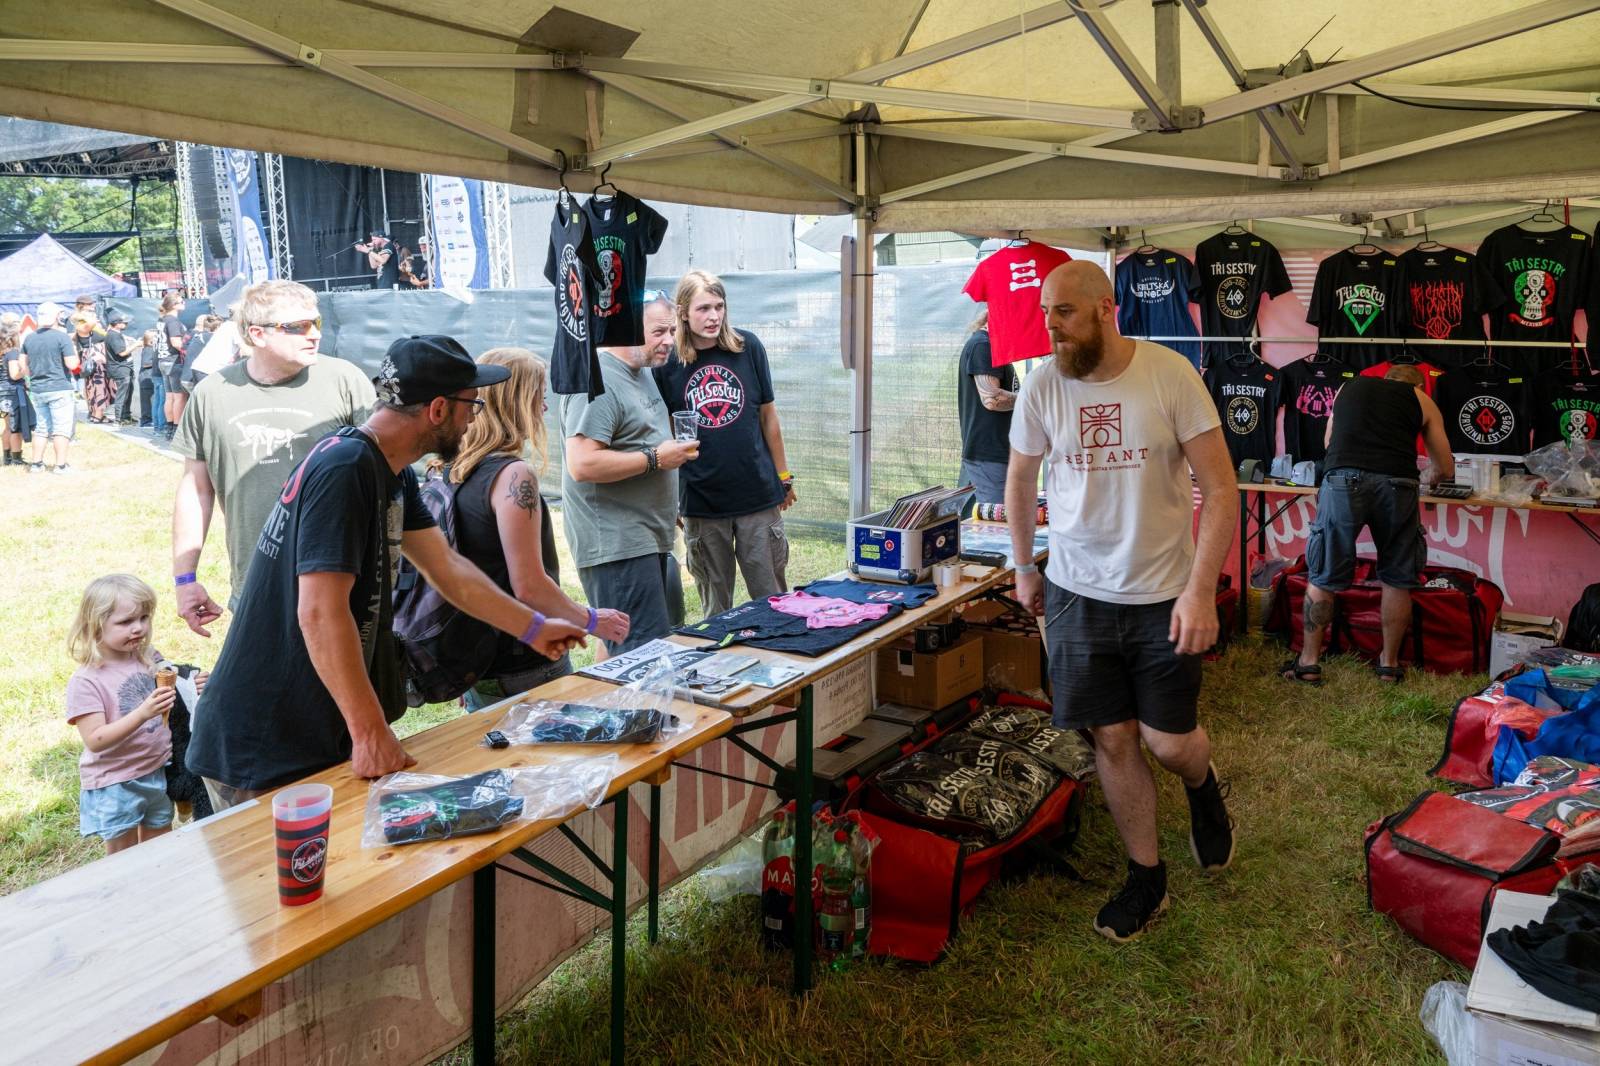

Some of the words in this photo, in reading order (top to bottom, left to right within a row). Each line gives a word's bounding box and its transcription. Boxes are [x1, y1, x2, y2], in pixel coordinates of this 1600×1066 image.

[1210, 261, 1226, 276] TŘI
[1526, 257, 1566, 278] SESTRY
[689, 366, 736, 387] ORIGINAL
[1221, 384, 1235, 396] TŘI
[1236, 384, 1267, 398] SESTRY
[1479, 398, 1508, 414] SESTRY
[716, 408, 738, 426] 1985
[1461, 413, 1485, 442] ORIGINAL
[1106, 447, 1149, 463] ANT
